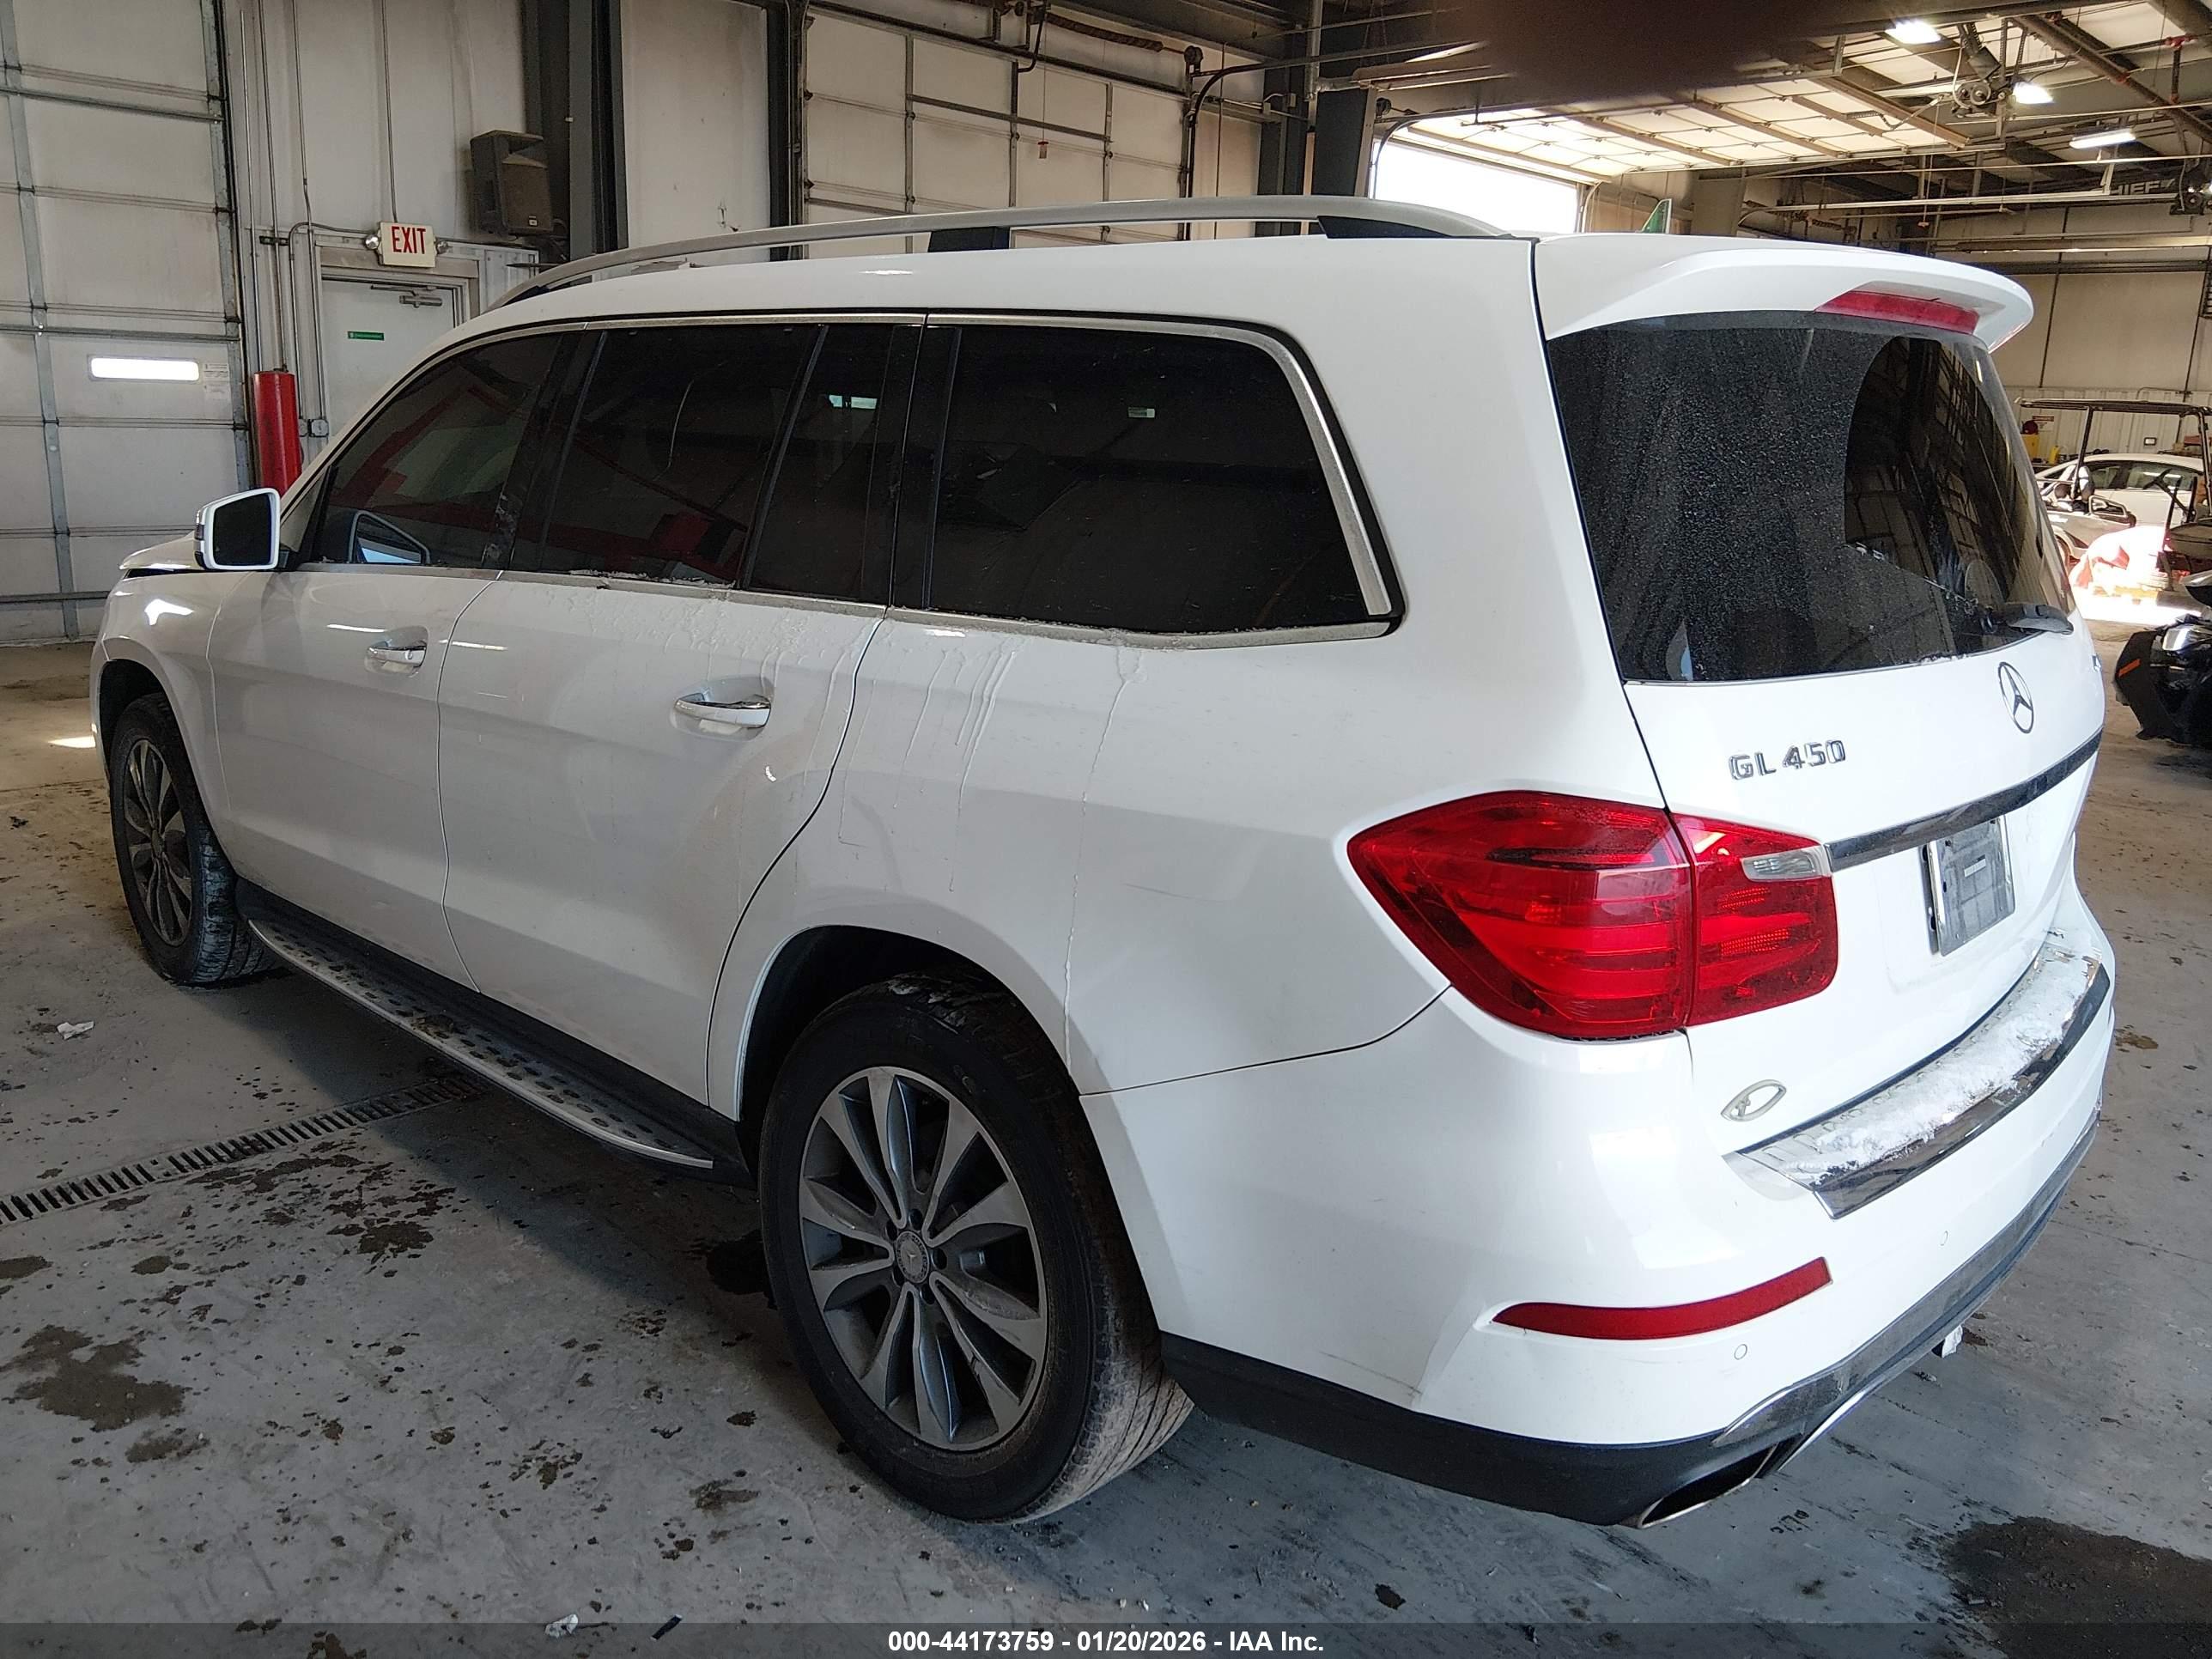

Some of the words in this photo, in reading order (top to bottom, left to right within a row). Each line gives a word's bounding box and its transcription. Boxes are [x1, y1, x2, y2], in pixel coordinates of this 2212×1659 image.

[2093, 180, 2161, 196] HIEF
[392, 226, 426, 254] EXIT
[1729, 752, 1777, 781] GL
[1782, 739, 1846, 769] 450
